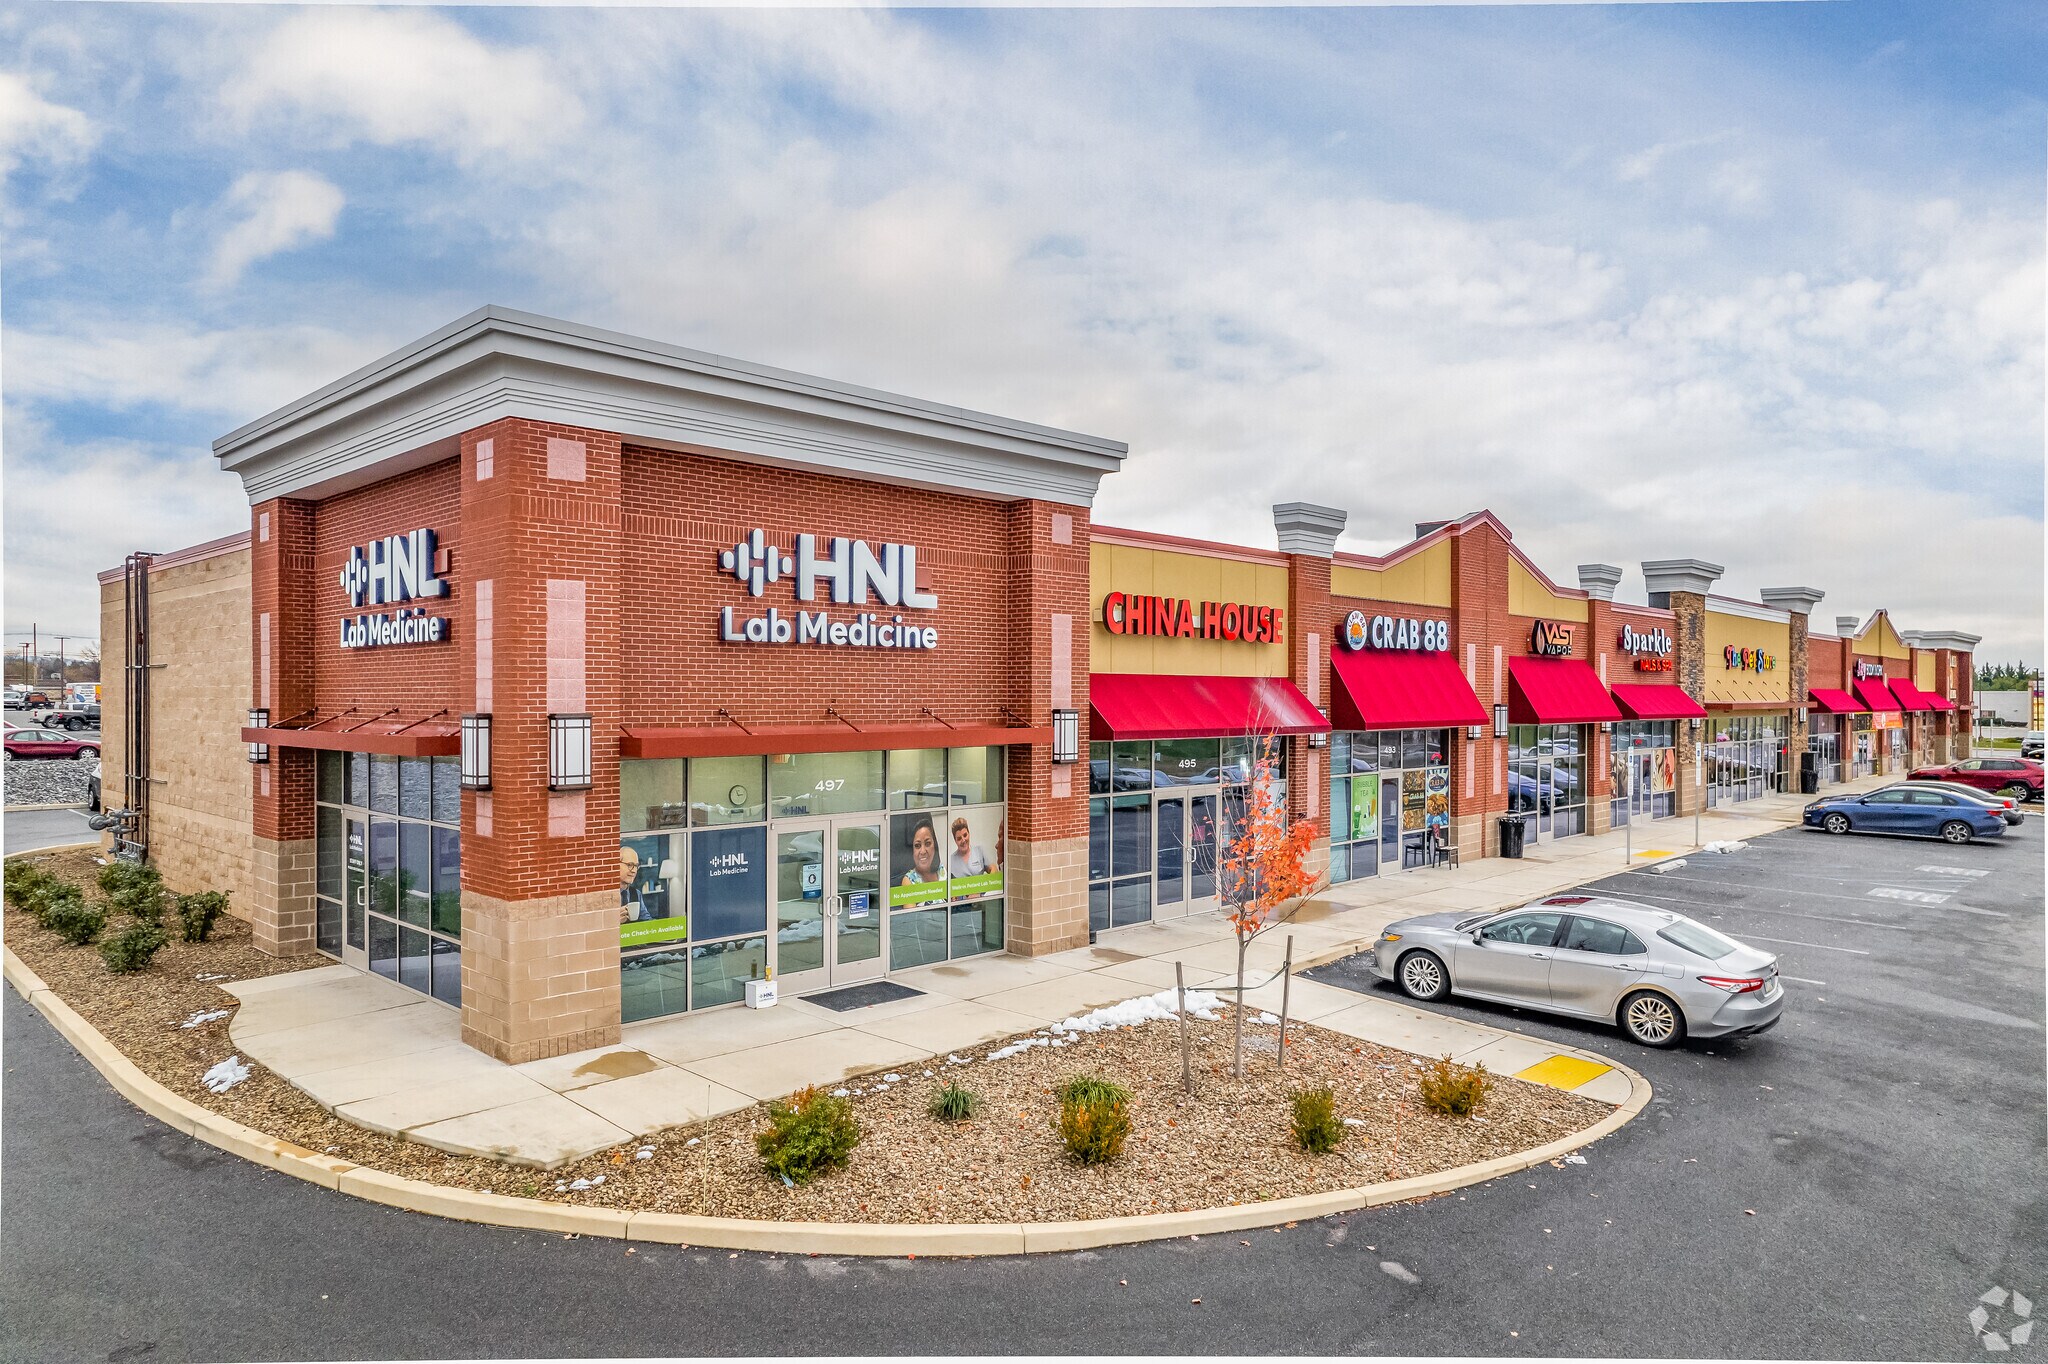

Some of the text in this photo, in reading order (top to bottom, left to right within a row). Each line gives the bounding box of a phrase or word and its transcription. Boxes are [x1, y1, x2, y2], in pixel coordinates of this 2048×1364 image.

[369, 528, 441, 604] HNL
[797, 533, 938, 609] HNL
[1103, 591, 1283, 643] CHINA HOUSE
[340, 608, 440, 648] Lab Medicine
[722, 606, 938, 648] Lab Medicine
[1372, 615, 1448, 651] CRAB 88
[1543, 621, 1576, 646] VAST
[1623, 624, 1672, 657] Sparkle
[1547, 645, 1573, 655] VAPOR
[1662, 659, 1672, 671] SPA
[1726, 645, 1776, 673] The Pet Store
[1384, 746, 1396, 754] 493
[1178, 759, 1196, 769] 495
[814, 779, 844, 791] 497
[1360, 789, 1369, 797] TEA
[791, 806, 809, 815] HNL
[722, 853, 748, 867] HNL
[852, 849, 878, 863] HNL
[722, 866, 748, 875] Medicine
[840, 864, 878, 874] Lab Medicine
[900, 890, 927, 898] Appointment
[631, 928, 657, 937] Check-in
[658, 924, 684, 933] Available
